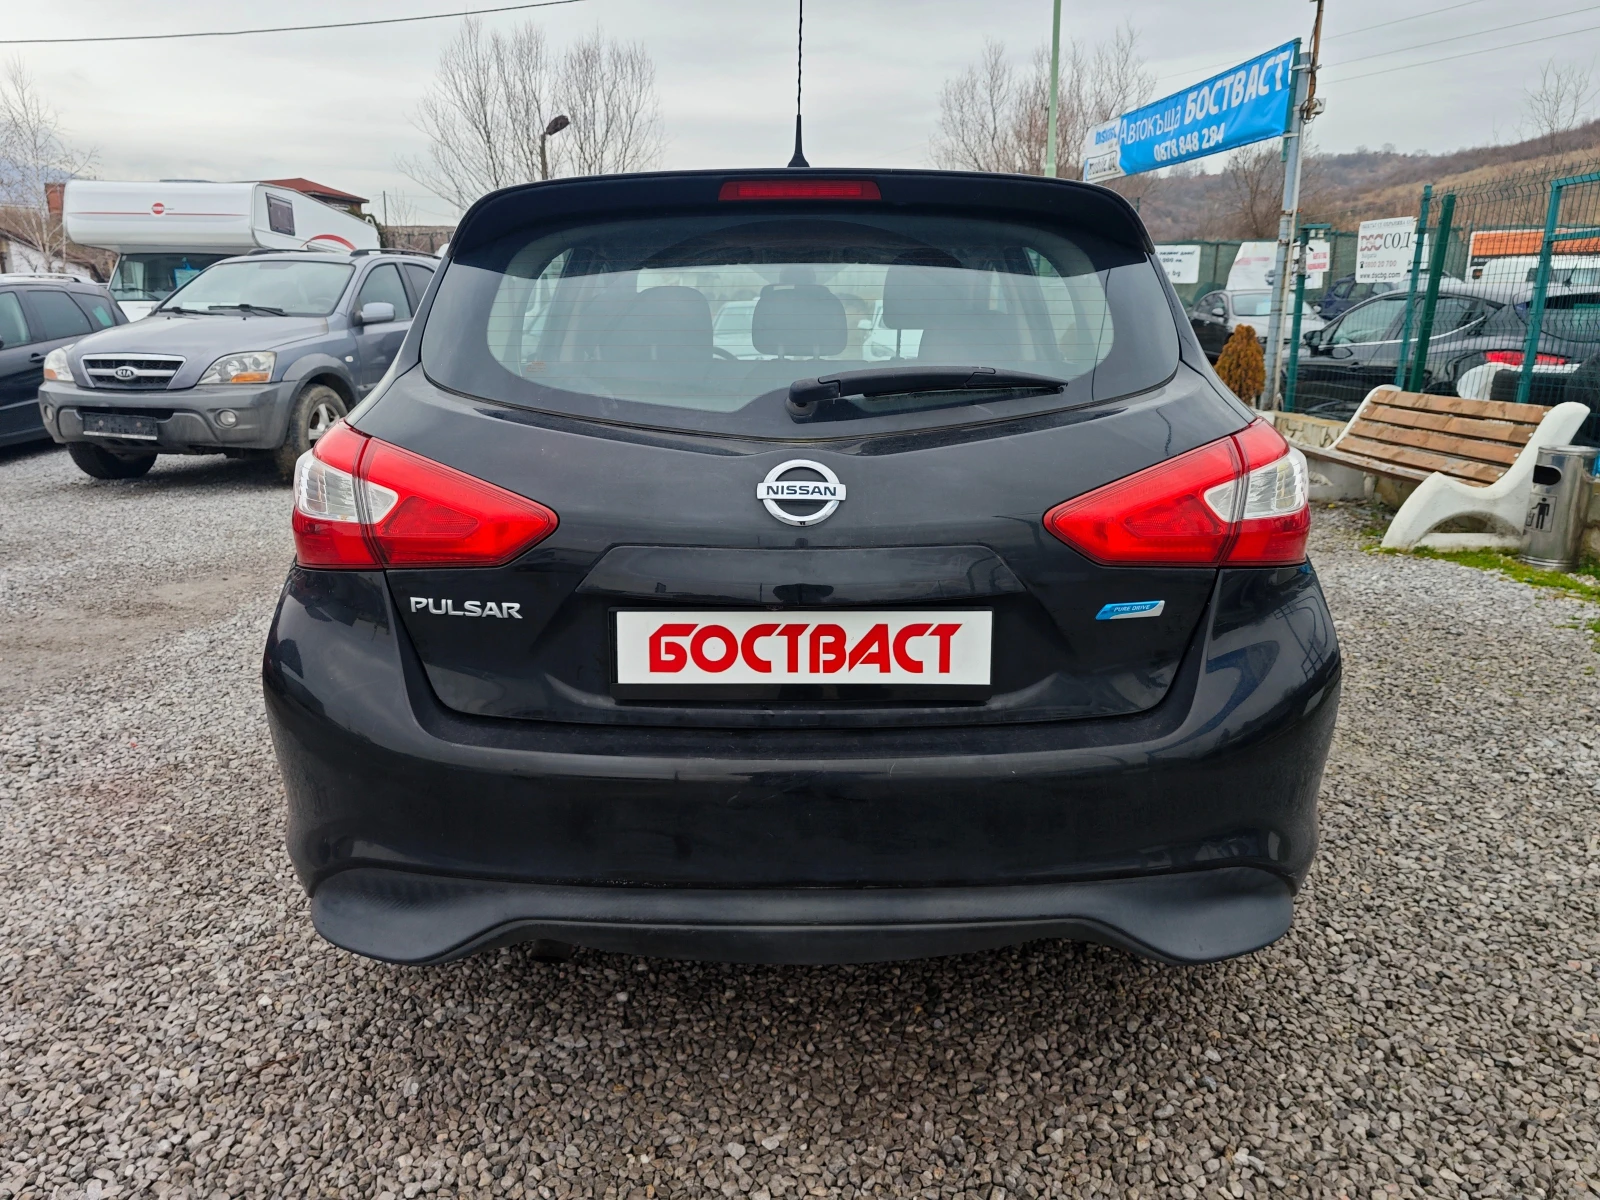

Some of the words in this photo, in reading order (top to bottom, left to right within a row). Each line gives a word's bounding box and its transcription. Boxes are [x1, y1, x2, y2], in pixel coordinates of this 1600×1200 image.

[1119, 105, 1182, 146] Автокъща
[1153, 138, 1179, 162] 0878
[1179, 131, 1200, 155] 848
[1201, 122, 1226, 149] 284
[117, 369, 132, 377] KIA
[766, 485, 837, 497] NISSAN
[409, 596, 524, 619] PULSAR
[649, 623, 963, 674] БОСТВАСТ
